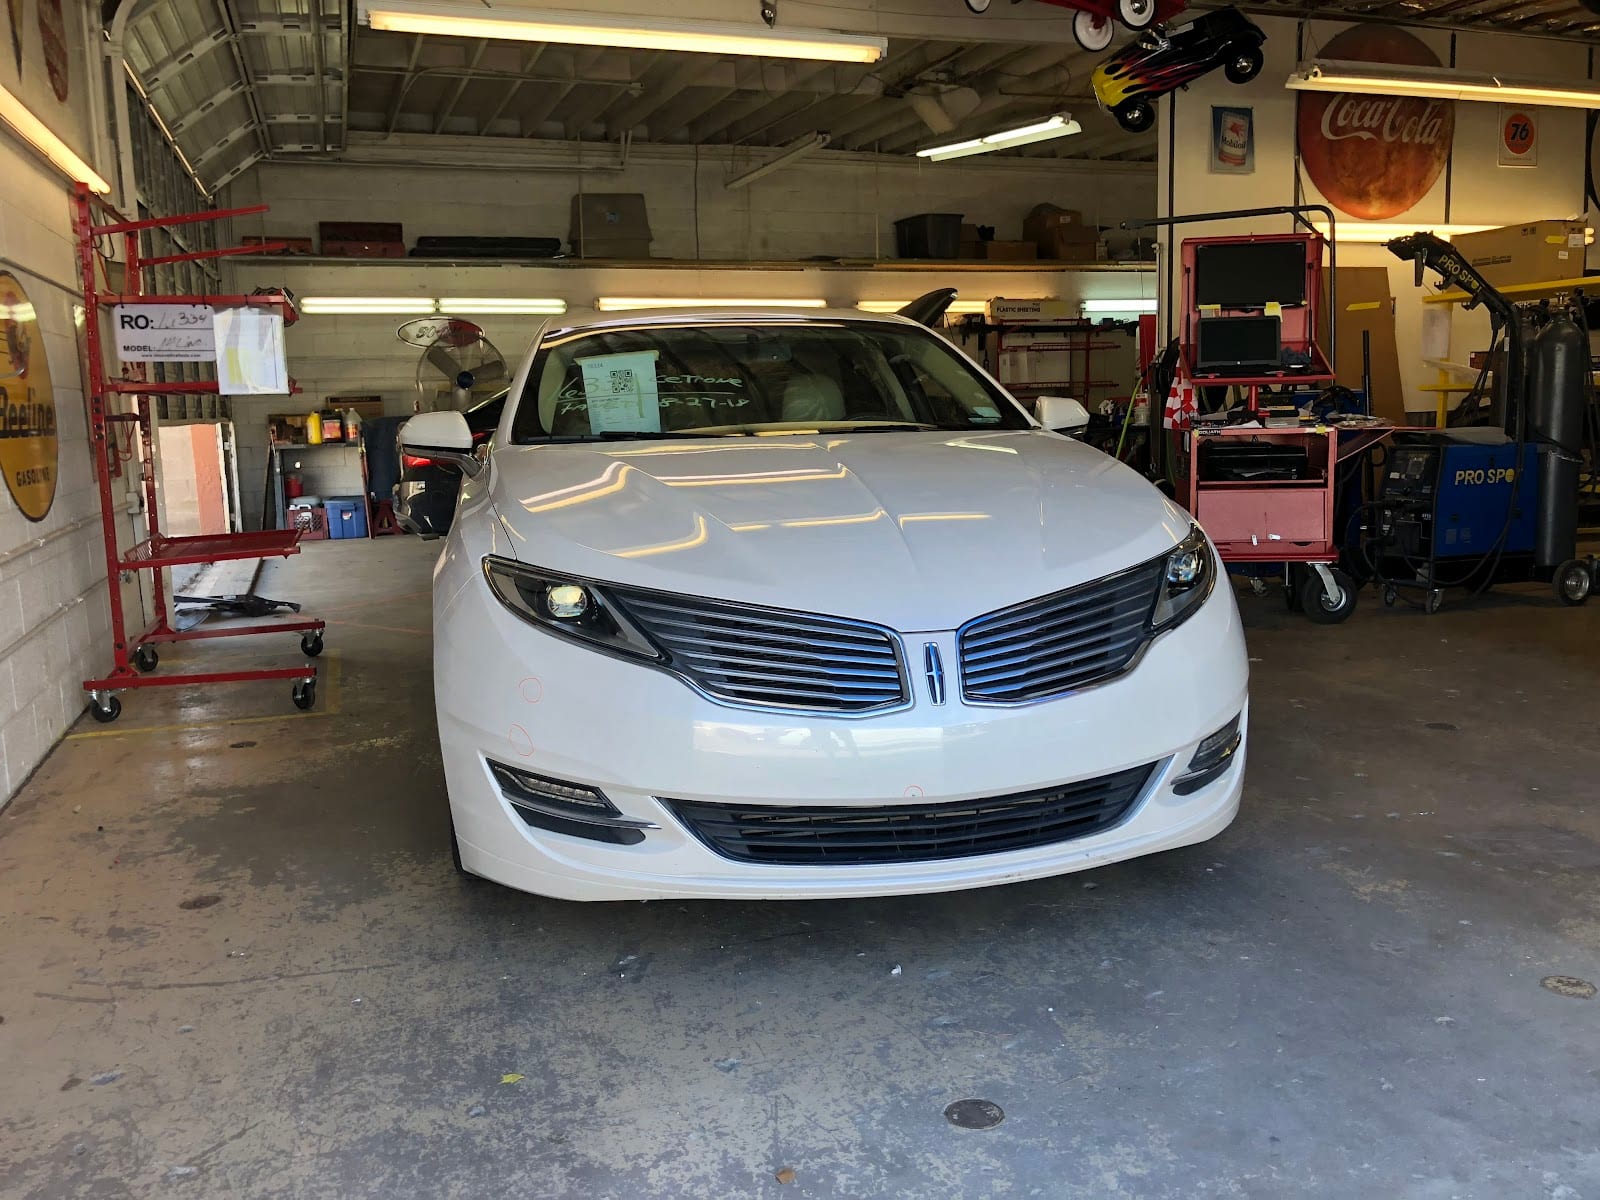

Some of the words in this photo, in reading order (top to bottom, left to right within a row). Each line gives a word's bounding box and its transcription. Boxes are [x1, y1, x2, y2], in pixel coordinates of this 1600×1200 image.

[1511, 122, 1530, 141] 76
[1439, 254, 1460, 275] PRO
[120, 314, 154, 330] RO:
[16, 466, 51, 487] GASOLINE
[1454, 470, 1485, 486] PRO
[1487, 468, 1523, 484] SPO
